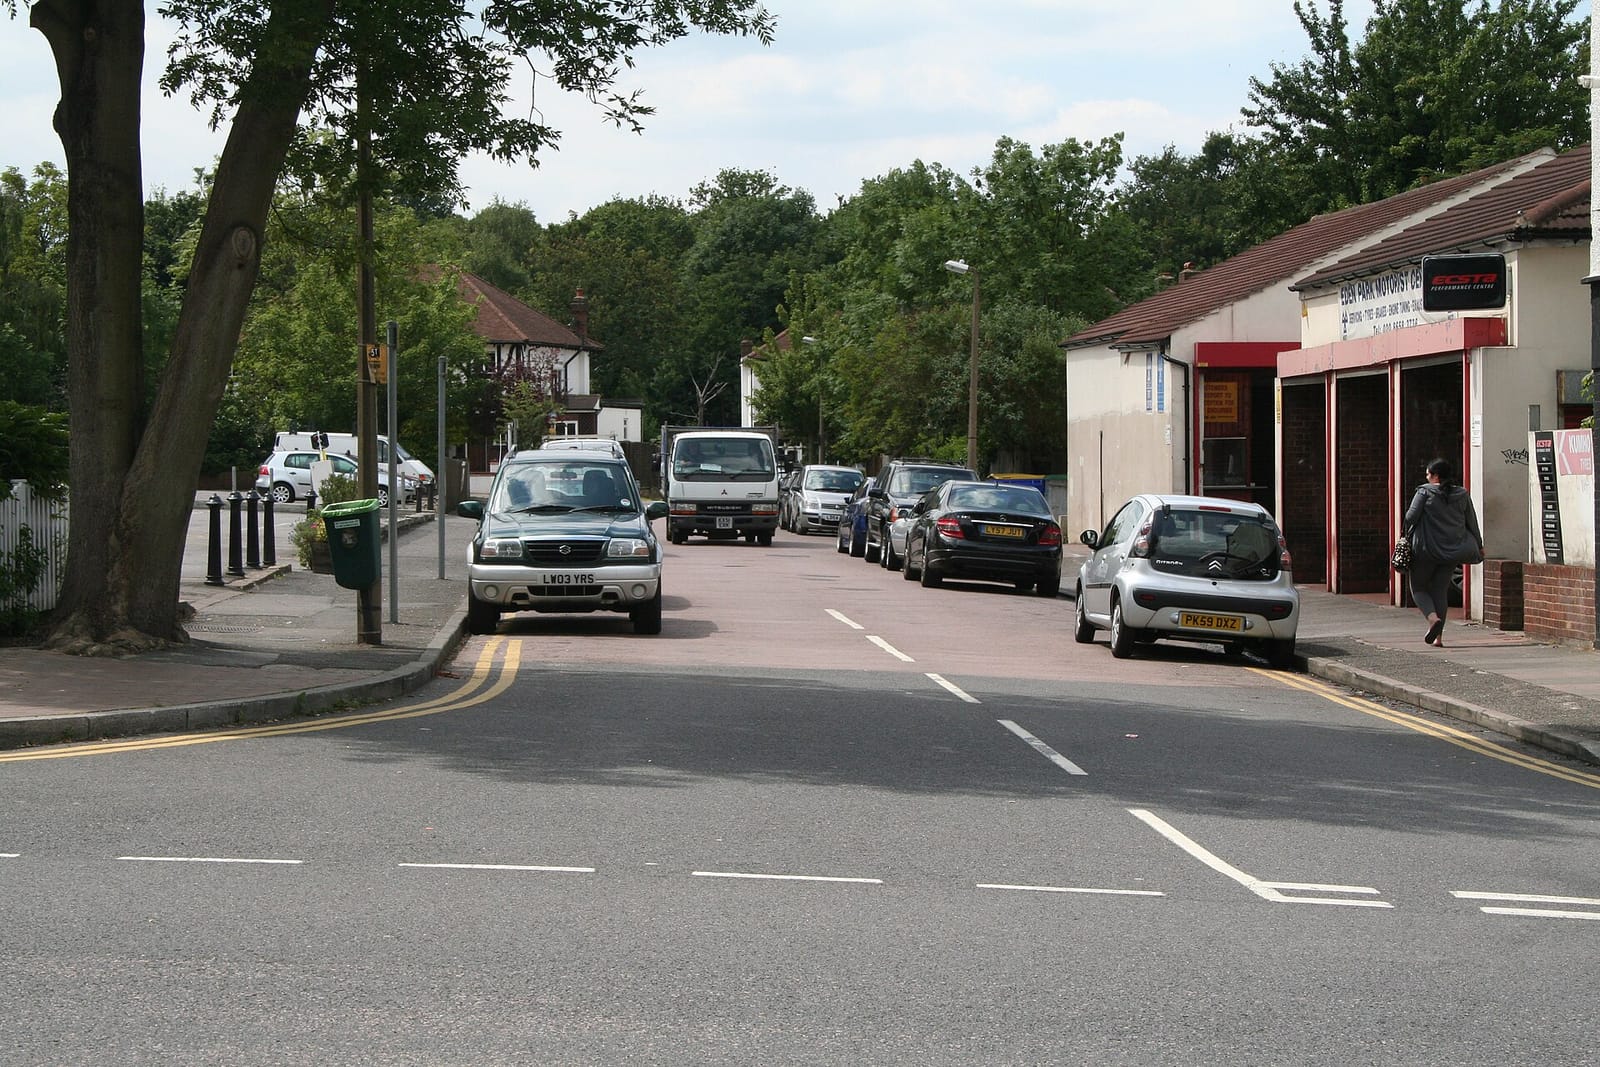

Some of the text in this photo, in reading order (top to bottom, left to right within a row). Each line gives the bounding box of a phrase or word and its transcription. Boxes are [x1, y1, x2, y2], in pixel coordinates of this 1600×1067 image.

[1341, 285, 1357, 306] EDEN
[1358, 281, 1375, 302] PARK
[1376, 271, 1408, 298] MOTORIST
[543, 573, 594, 584] LW03 YRS
[1185, 614, 1237, 629] PK59 DXZ
